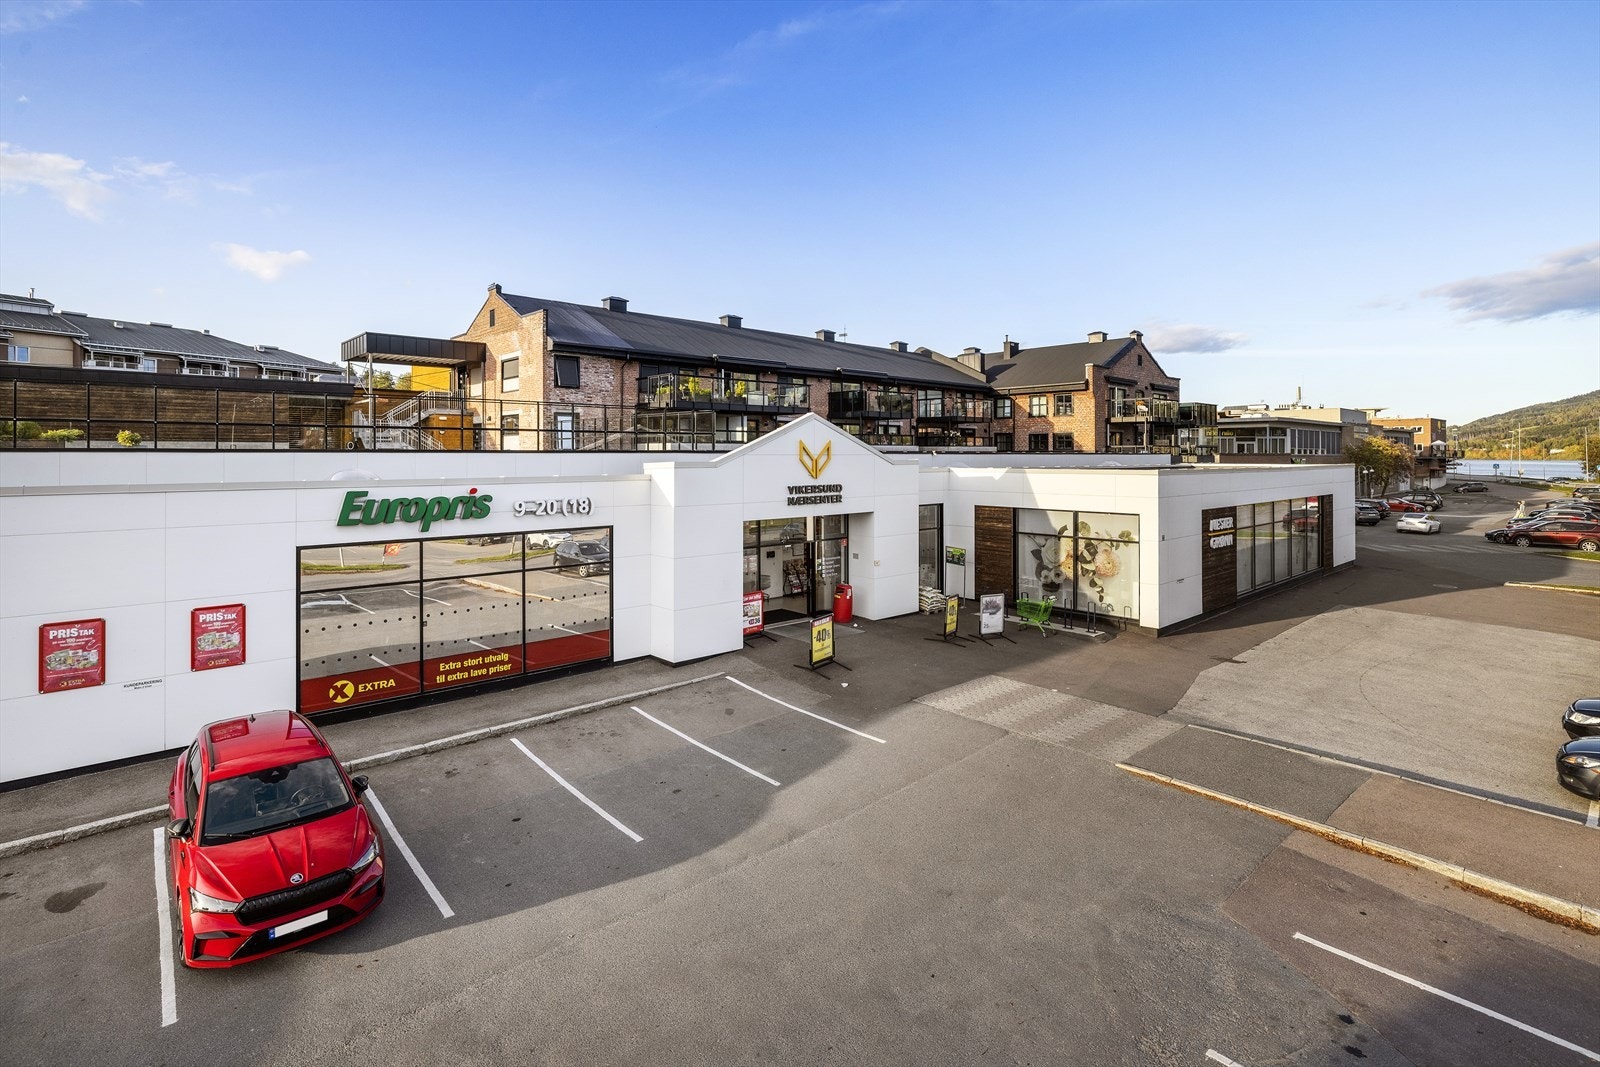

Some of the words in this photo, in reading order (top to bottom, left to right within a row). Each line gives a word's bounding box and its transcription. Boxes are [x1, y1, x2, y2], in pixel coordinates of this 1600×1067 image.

[787, 484, 842, 495] VIKERSUND
[562, 497, 594, 517] (18)
[787, 495, 842, 506] NÆRSENTER
[337, 488, 493, 532] Europris
[1209, 517, 1234, 531] MESTER
[439, 662, 461, 672] Extra
[463, 658, 483, 667] stort
[484, 652, 509, 665] utvalg
[436, 675, 445, 684] til
[447, 671, 469, 681] extra
[470, 667, 487, 678] lave
[489, 662, 512, 676] priser
[123, 679, 163, 688] KUNDEPARKERING
[358, 679, 396, 693] EXTRA
